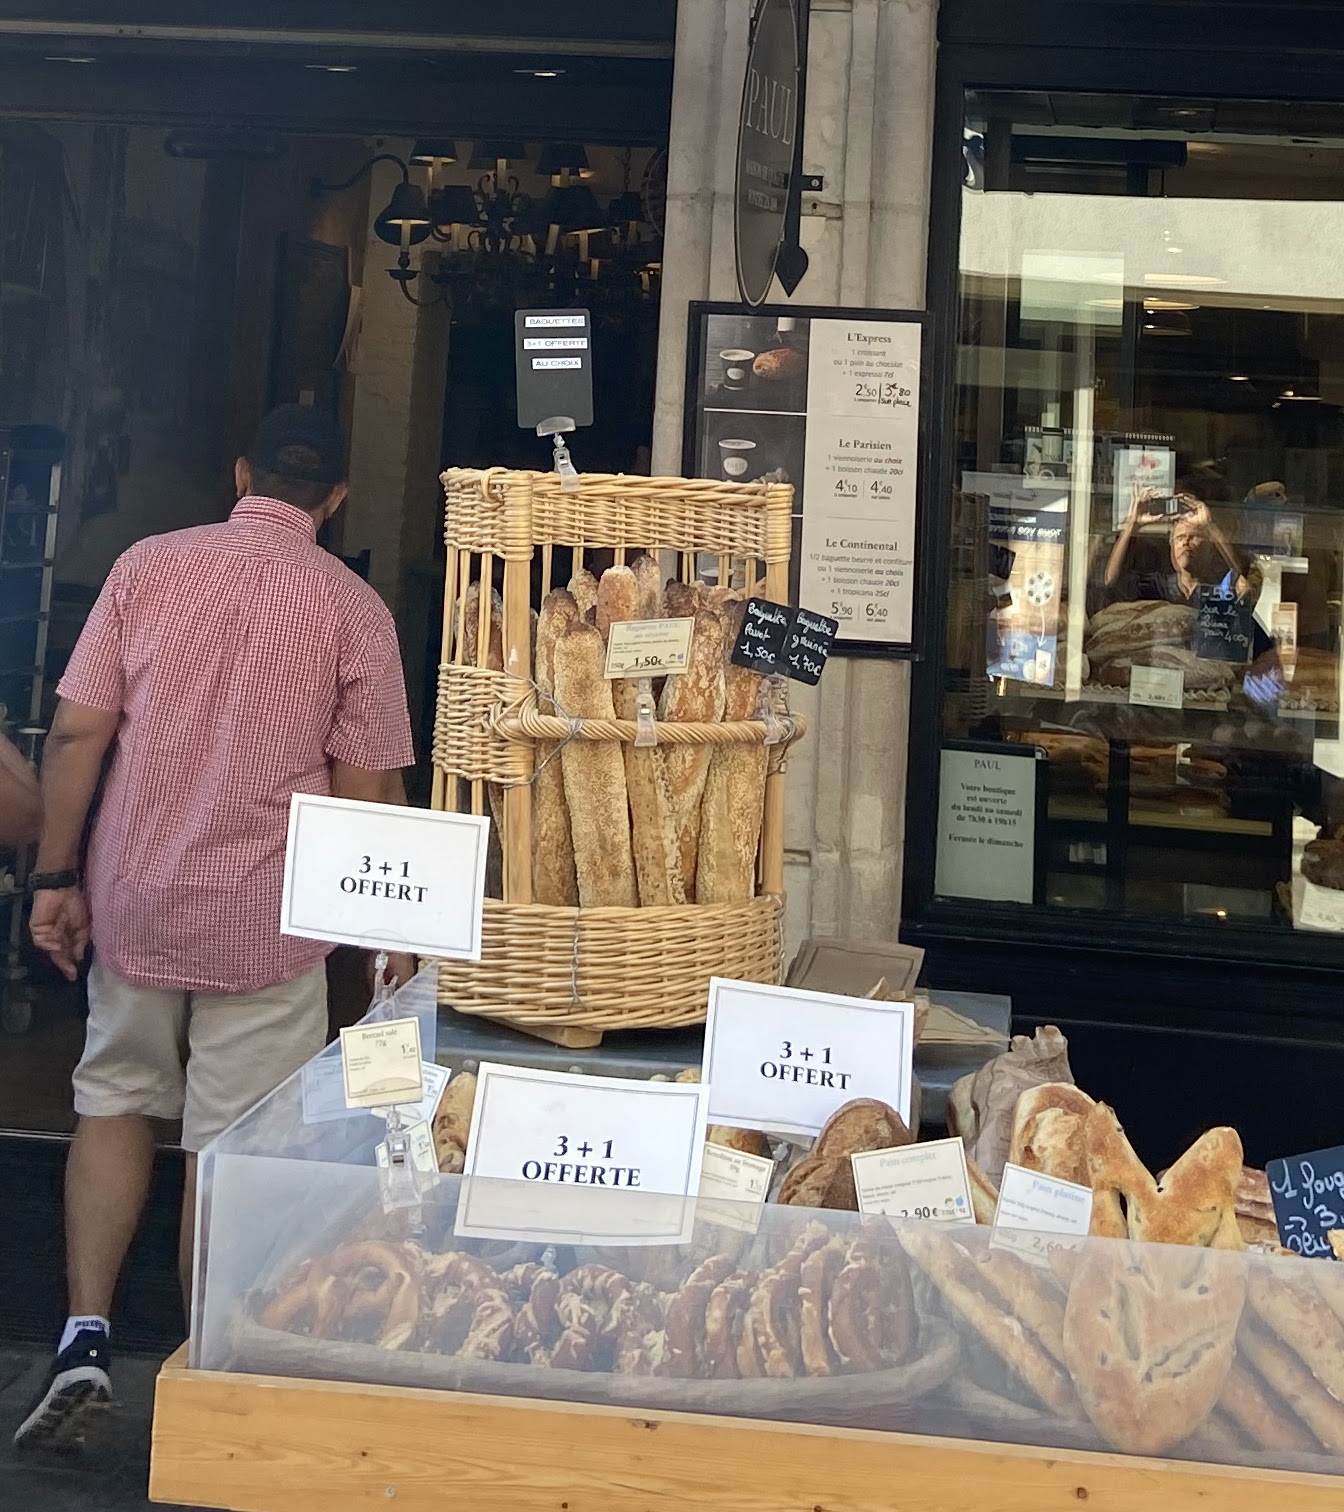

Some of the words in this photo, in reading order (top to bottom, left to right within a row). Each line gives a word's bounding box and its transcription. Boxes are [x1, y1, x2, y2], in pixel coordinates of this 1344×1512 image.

[745, 68, 792, 145] PAUL
[847, 332, 892, 345] L'Express
[856, 349, 887, 357] croissant
[535, 359, 548, 367] AU
[550, 359, 580, 367] CHOIX
[839, 438, 851, 448] Le
[853, 439, 892, 451] Parisien
[825, 538, 838, 548] Le
[839, 539, 898, 552] Continental
[974, 759, 1001, 770] PAUL
[960, 782, 981, 792] Votre
[983, 784, 1016, 796] boutique
[951, 803, 962, 811] du
[963, 803, 983, 813] lundi
[996, 808, 1023, 817] samedi
[956, 813, 966, 821] de
[987, 837, 1024, 849] dimanche
[359, 855, 372, 874] 3
[378, 861, 393, 876] +
[400, 860, 411, 879] 1
[339, 876, 429, 903] OFFERT
[779, 1041, 793, 1059] 3
[799, 1047, 814, 1062] +
[821, 1046, 833, 1065] 1
[759, 1061, 852, 1090] OFFERT
[553, 1135, 568, 1158] 3
[576, 1141, 594, 1159] +
[603, 1139, 615, 1160] 1
[521, 1160, 642, 1188] OFFERTE
